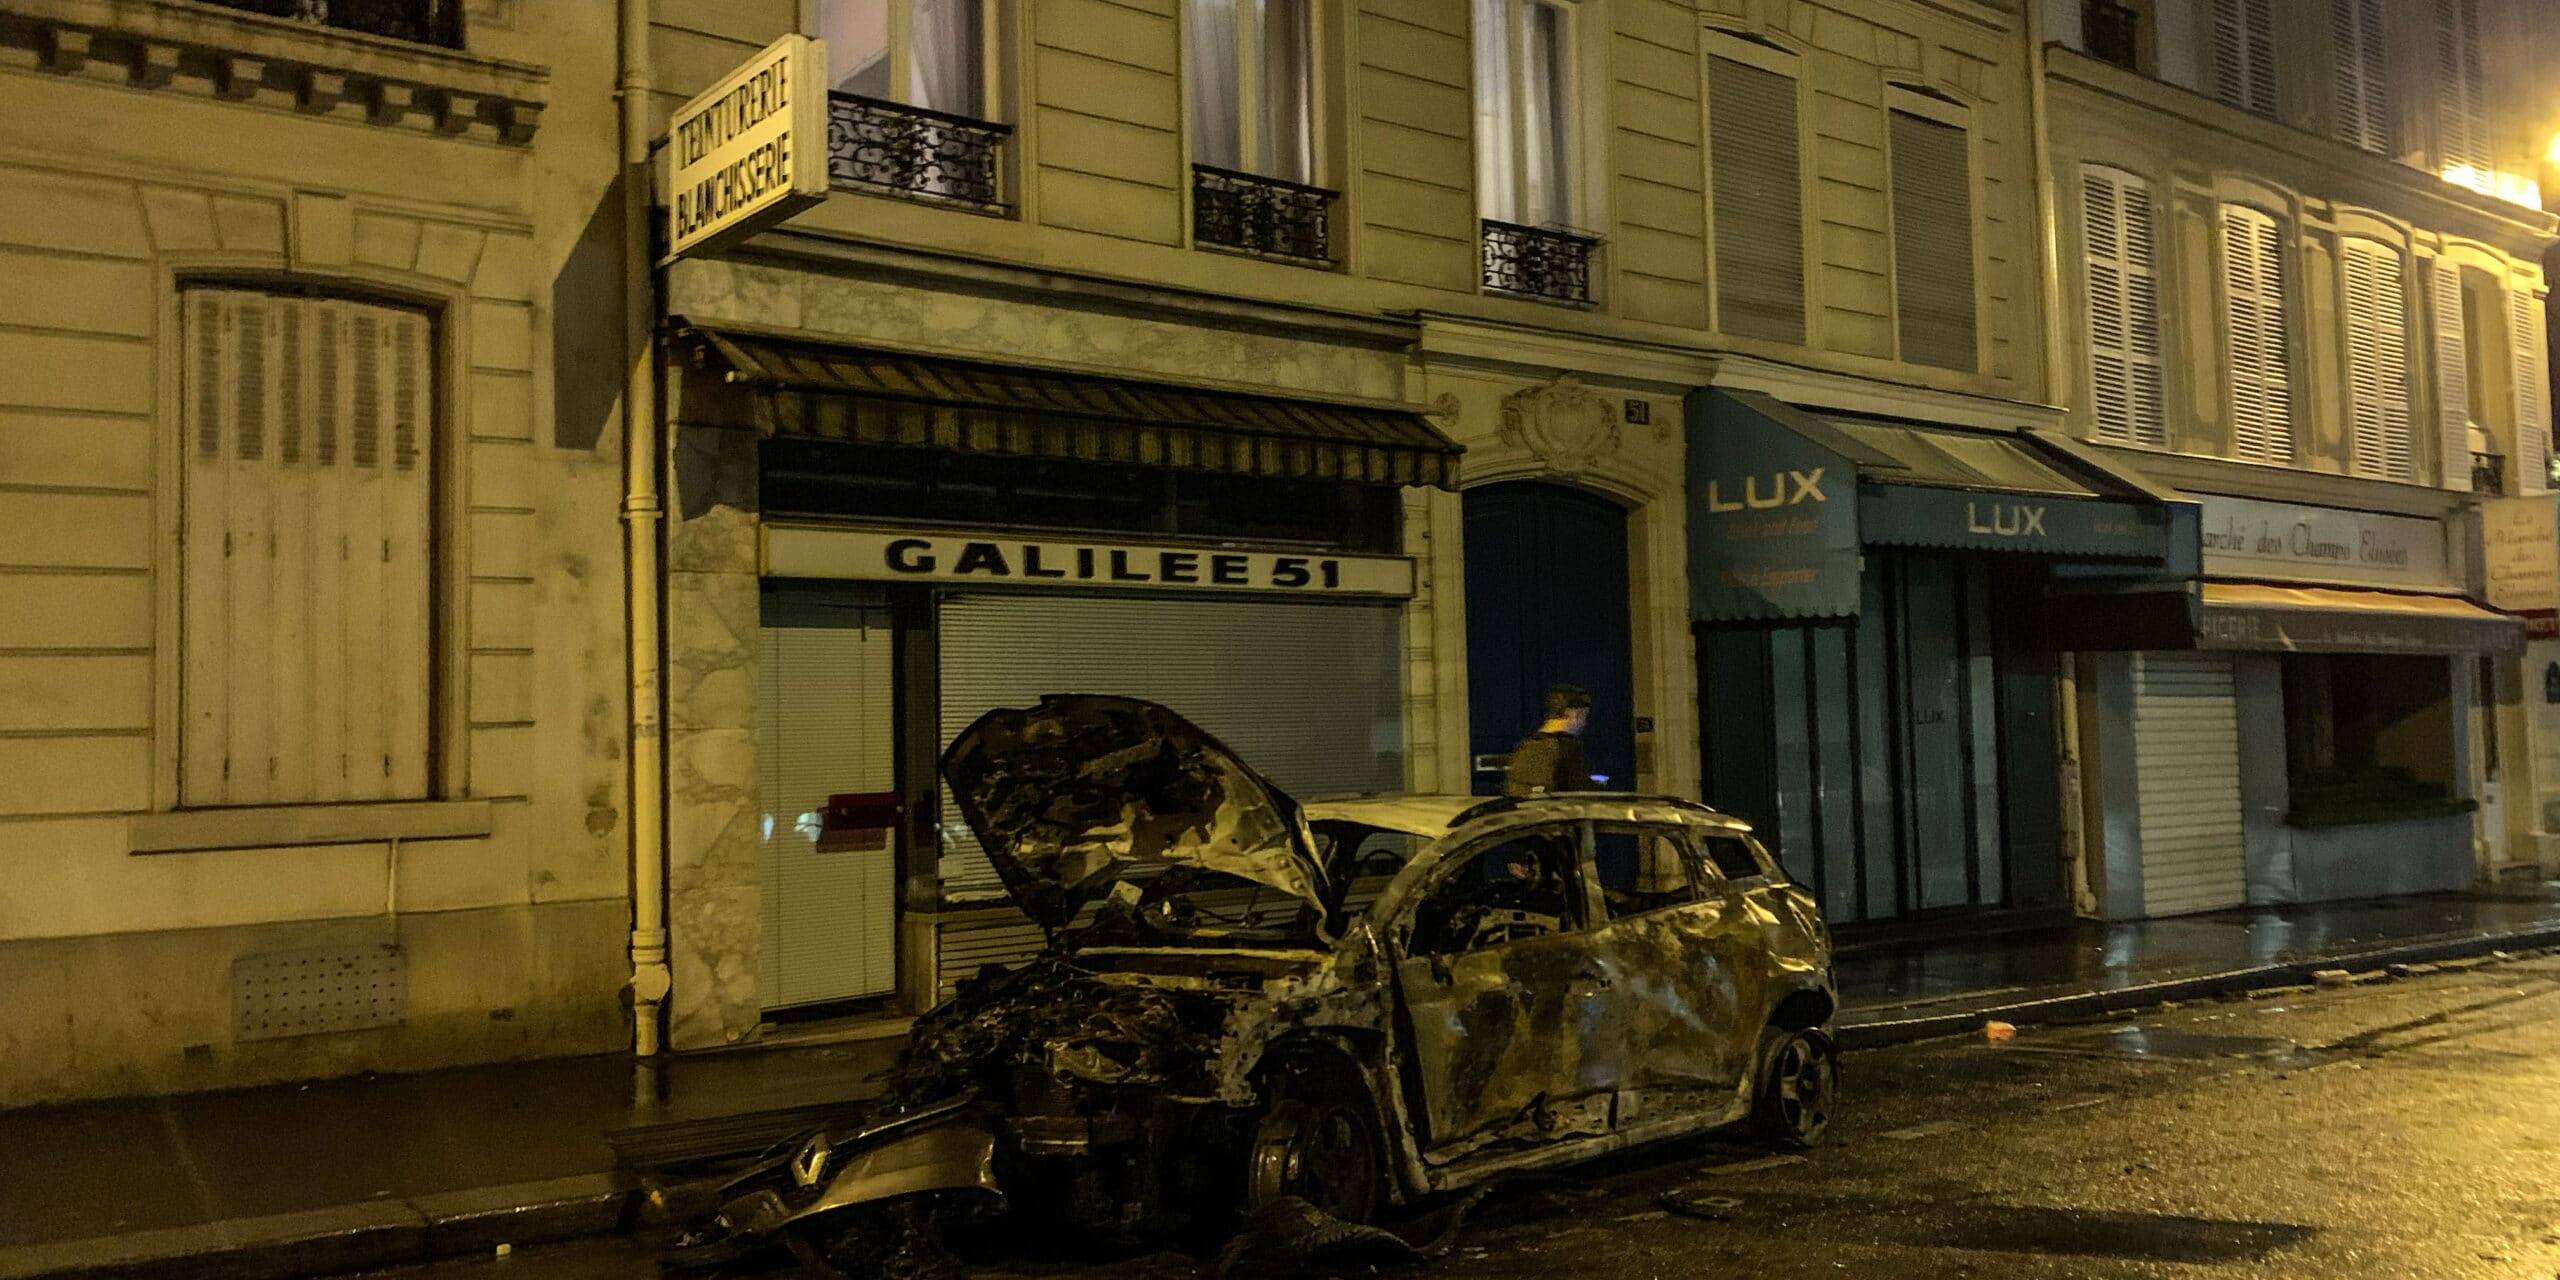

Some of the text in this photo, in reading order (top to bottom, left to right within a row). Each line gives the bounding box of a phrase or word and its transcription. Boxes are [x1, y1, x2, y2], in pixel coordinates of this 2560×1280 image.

[677, 56, 788, 171] TEINTURERIE
[677, 130, 791, 240] BLANCHISSERIE
[1630, 401, 1646, 423] 51
[1708, 466, 1827, 513] LUX
[1967, 501, 2047, 537] LUX
[2201, 514, 2245, 551] arché
[883, 537, 1340, 590] GALILEE 51
